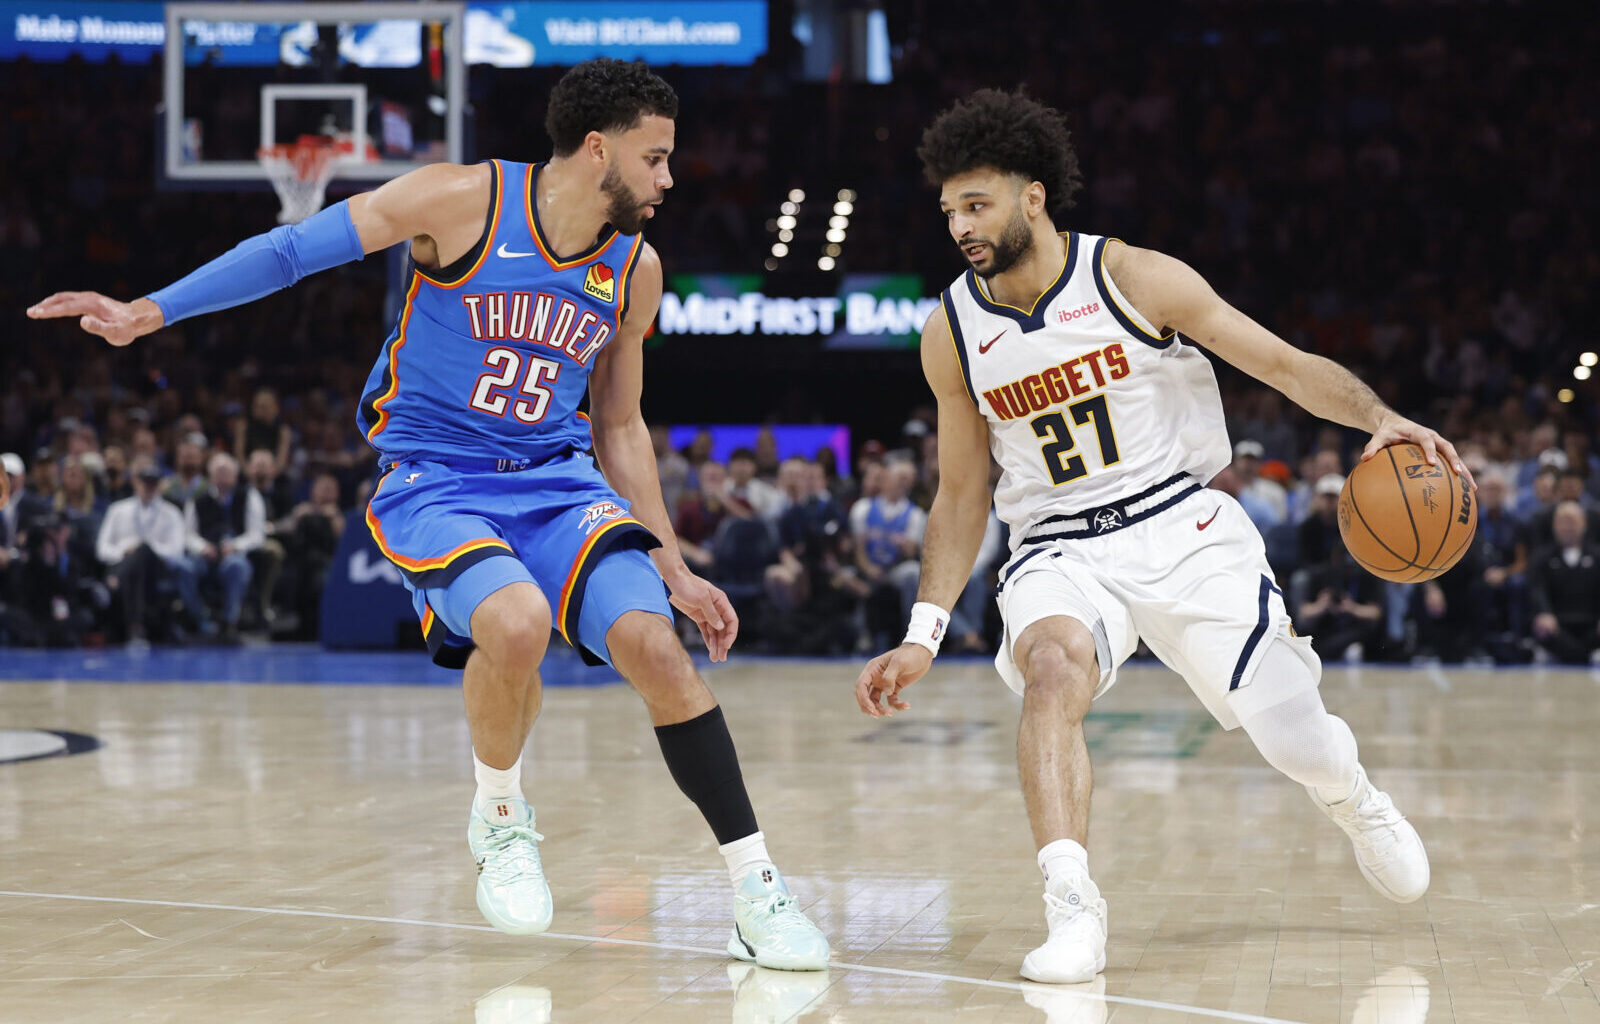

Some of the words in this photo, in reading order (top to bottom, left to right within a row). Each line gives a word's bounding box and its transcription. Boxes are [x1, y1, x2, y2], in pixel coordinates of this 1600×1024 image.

[80, 16, 165, 45] Momen
[462, 291, 612, 367] THUNDER
[1058, 302, 1100, 323] ibotta
[468, 346, 562, 425] 25
[982, 343, 1131, 421] NUGGETS
[1029, 392, 1121, 486] 27
